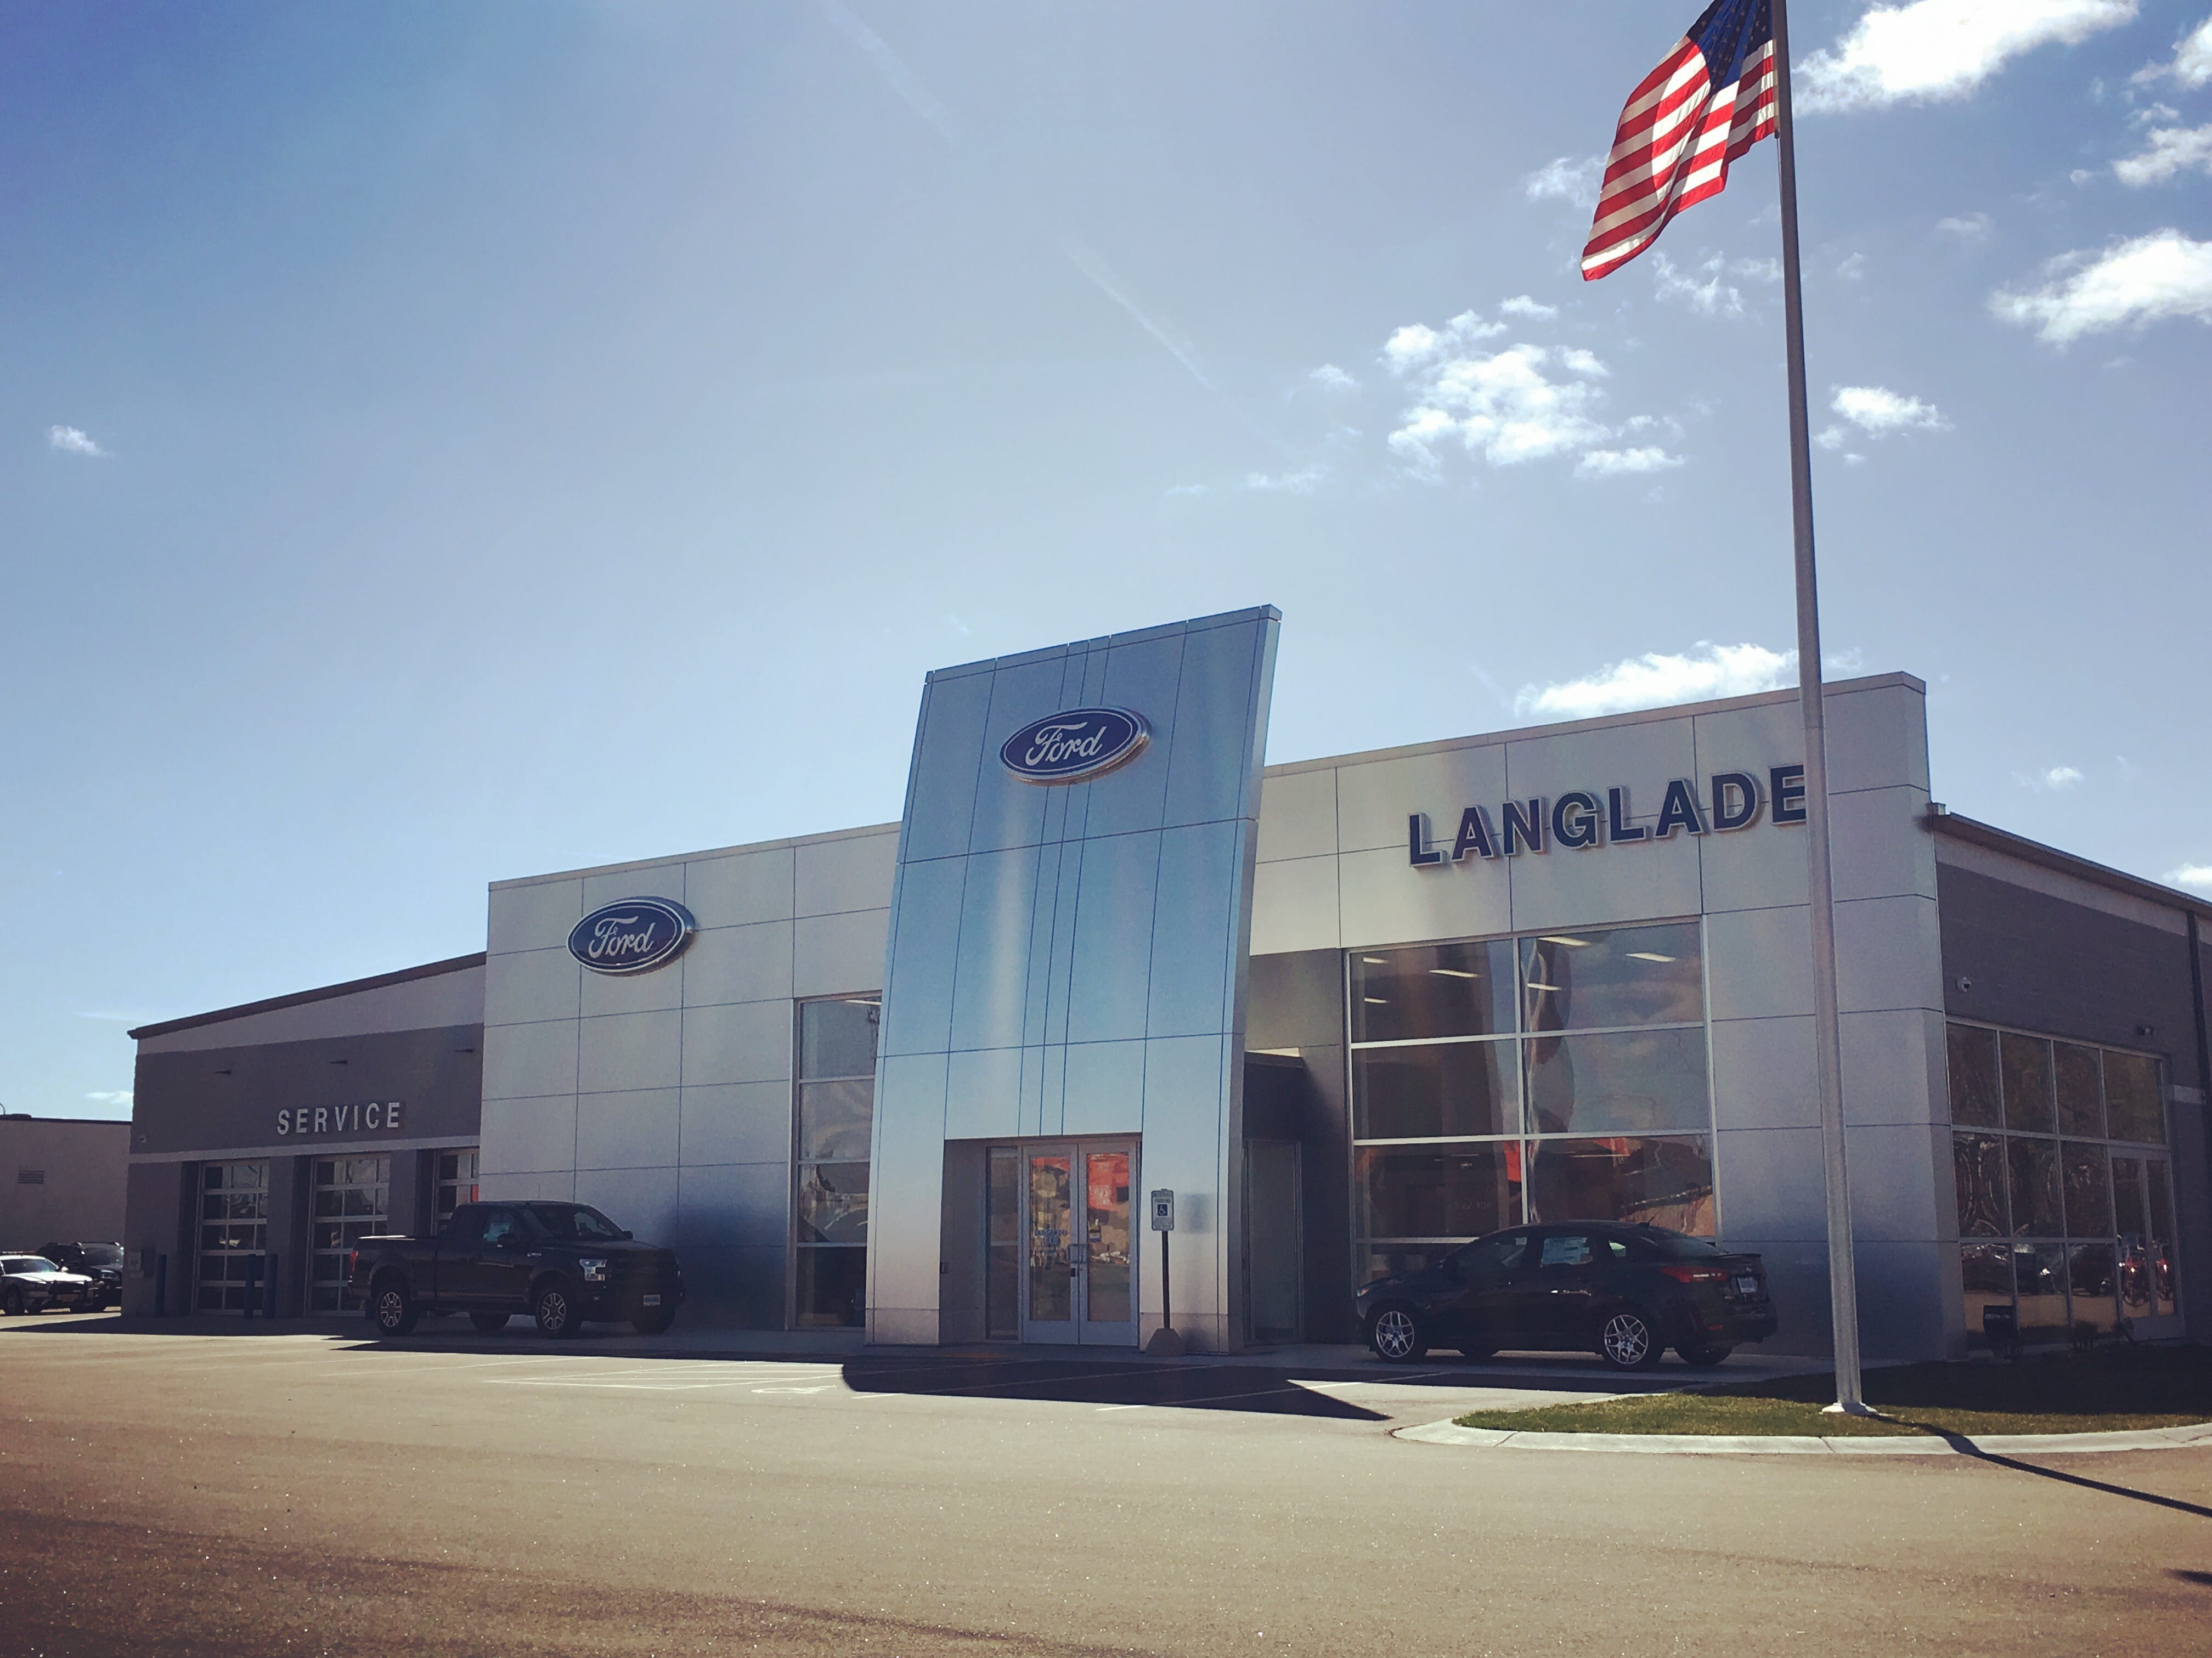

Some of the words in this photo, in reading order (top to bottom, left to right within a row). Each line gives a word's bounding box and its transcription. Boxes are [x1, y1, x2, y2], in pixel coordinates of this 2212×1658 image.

[1025, 721, 1107, 766] Ford
[1407, 763, 1807, 867] LANGLADE
[588, 916, 656, 958] Ford
[276, 1102, 400, 1135] SERVICE
